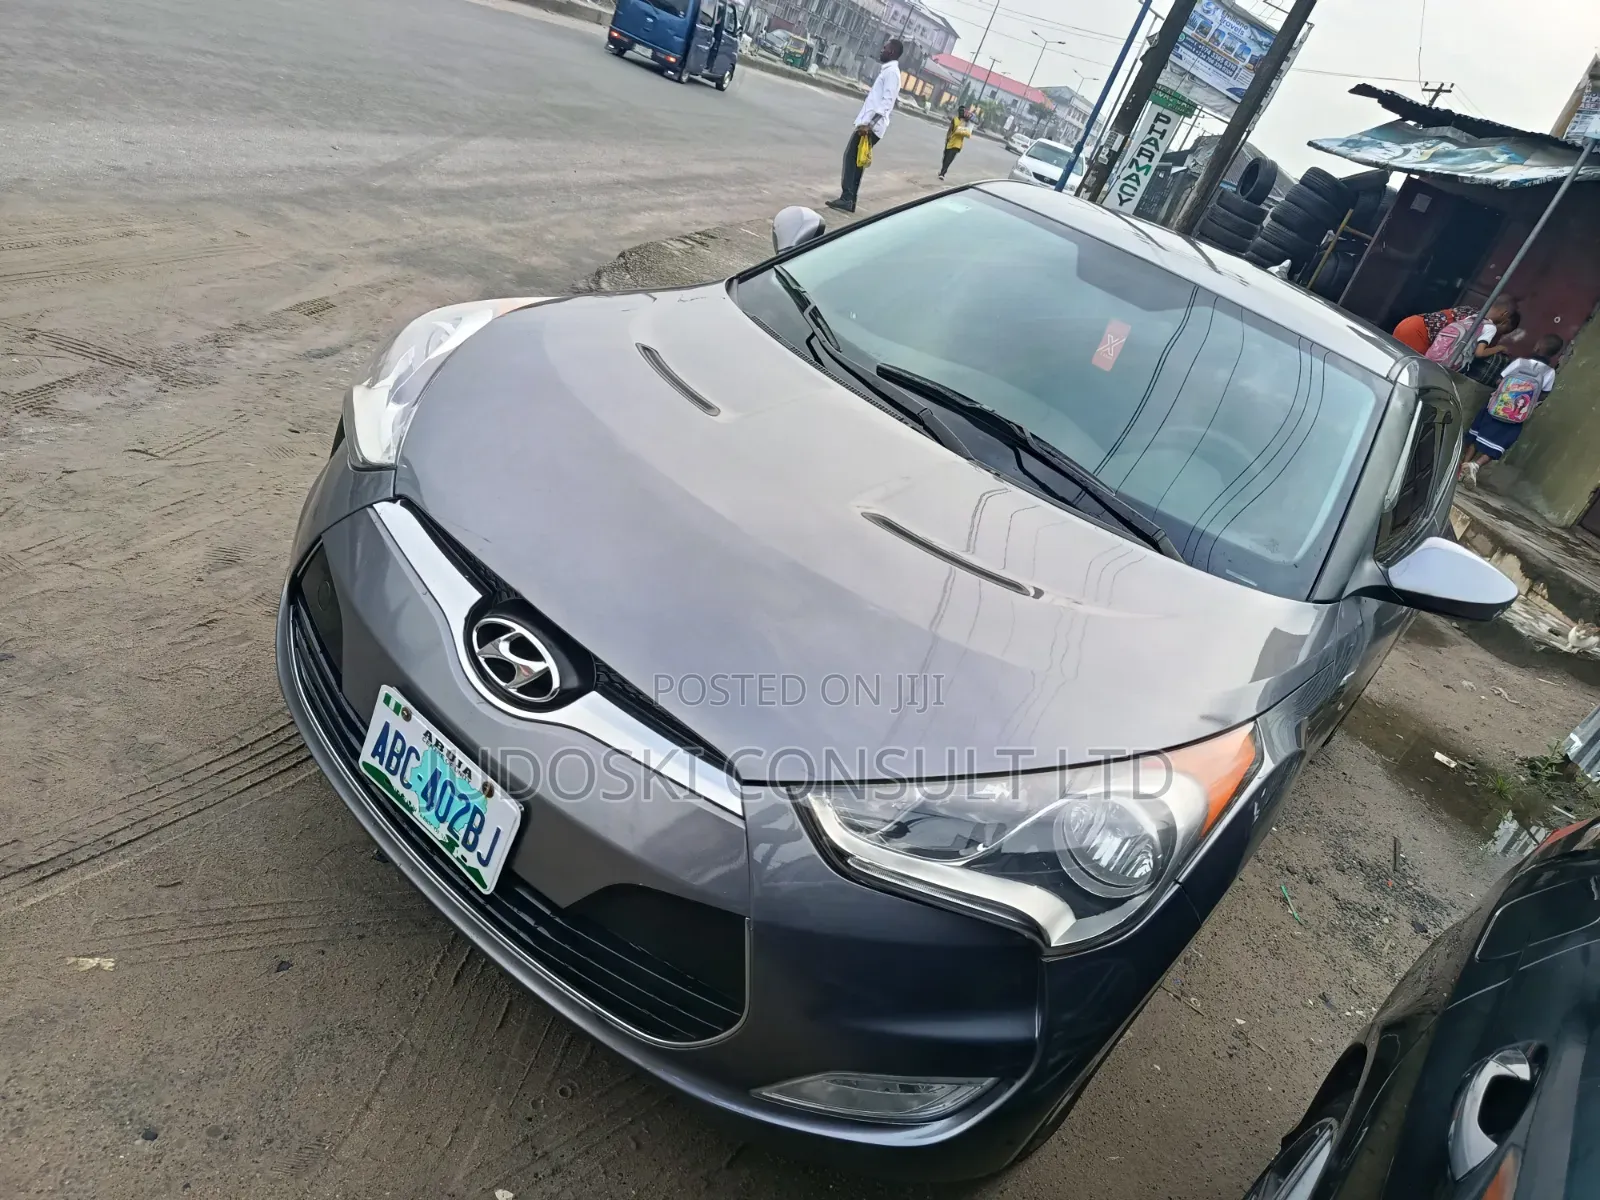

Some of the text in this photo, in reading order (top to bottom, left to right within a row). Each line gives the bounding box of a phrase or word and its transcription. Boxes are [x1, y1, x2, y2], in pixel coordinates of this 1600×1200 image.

[1220, 16, 1245, 36] Travels
[1221, 9, 1249, 30] Emiliano
[1117, 112, 1172, 206] PHARMACY
[422, 729, 473, 781] ABUJA
[370, 720, 502, 868] ABC-402BJ
